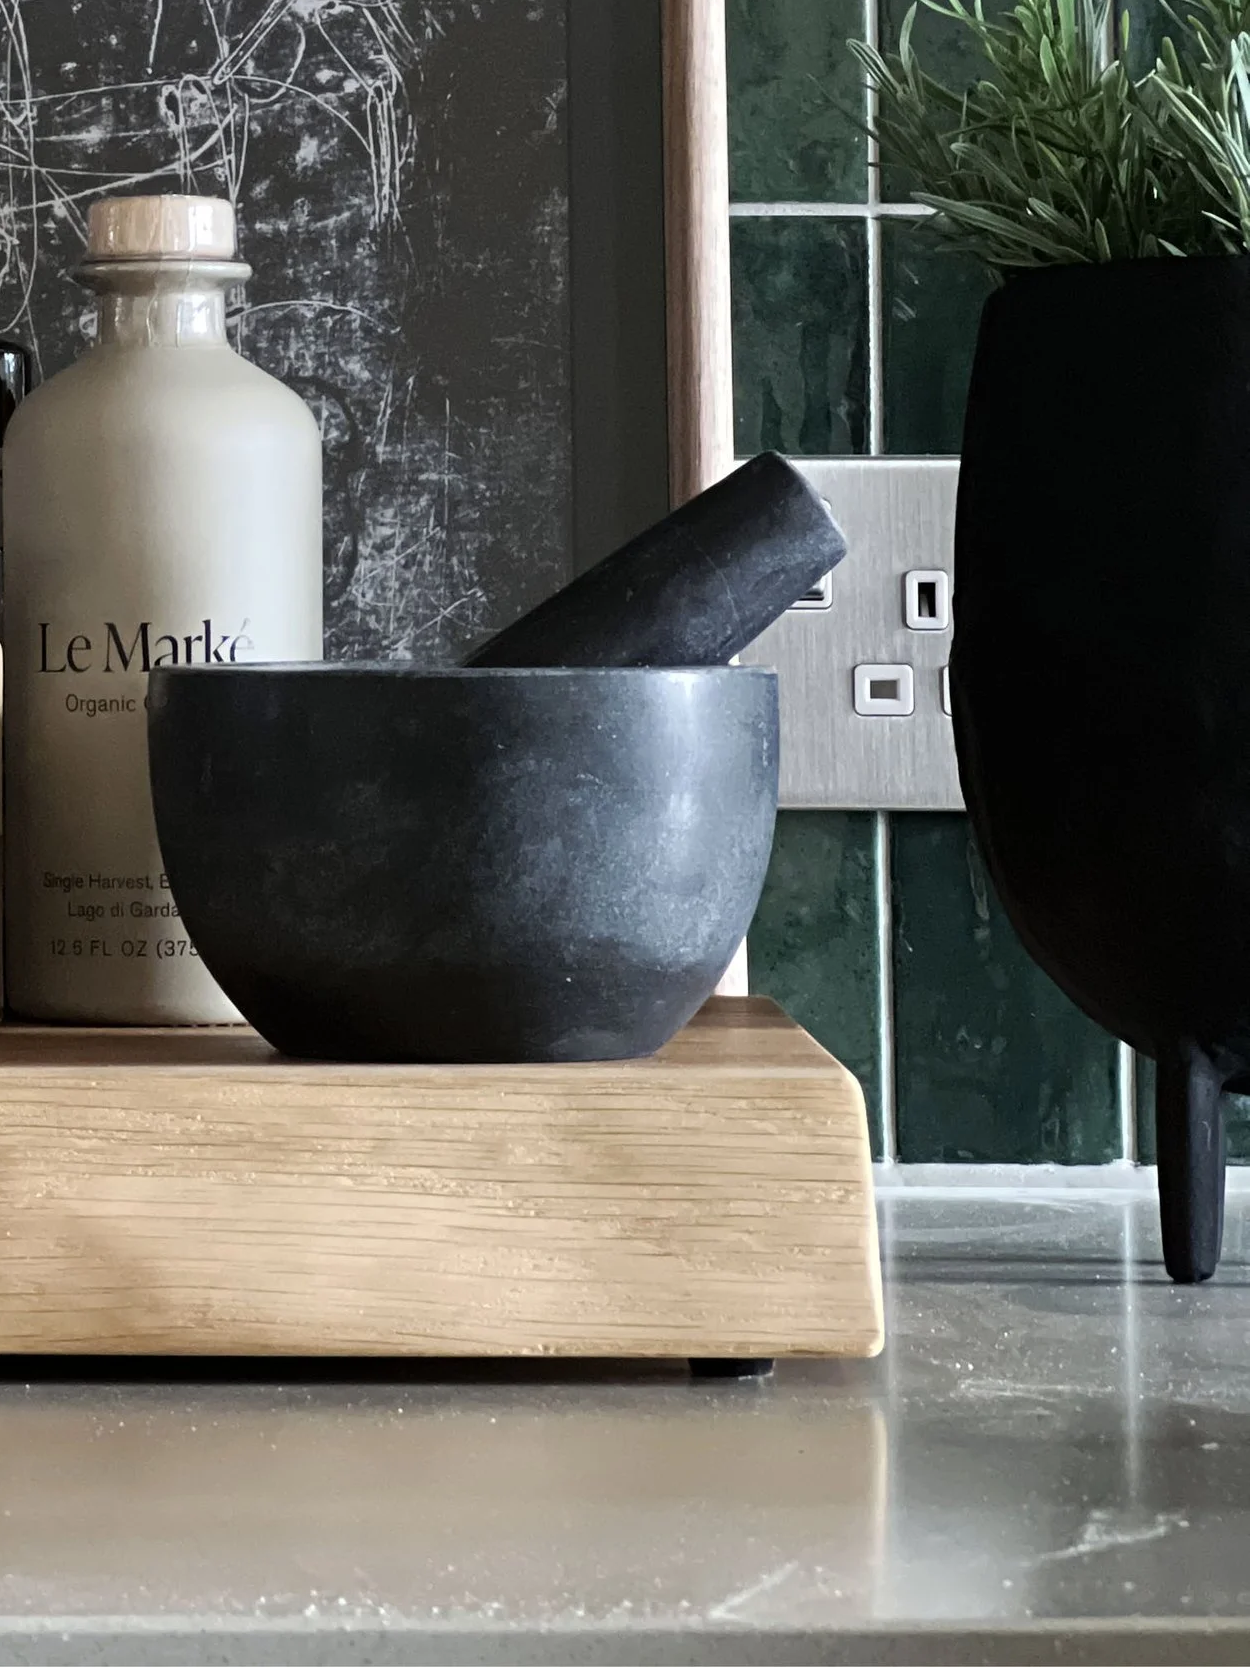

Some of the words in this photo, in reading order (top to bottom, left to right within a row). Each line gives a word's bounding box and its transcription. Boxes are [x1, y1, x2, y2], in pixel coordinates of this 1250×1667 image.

[37, 622, 92, 674] Le
[104, 617, 256, 674] Marké
[64, 693, 137, 718] Organic
[42, 871, 84, 893] Single
[67, 901, 105, 922] Lago
[110, 901, 124, 918] di
[89, 940, 112, 957] FL
[121, 940, 148, 957] OZ
